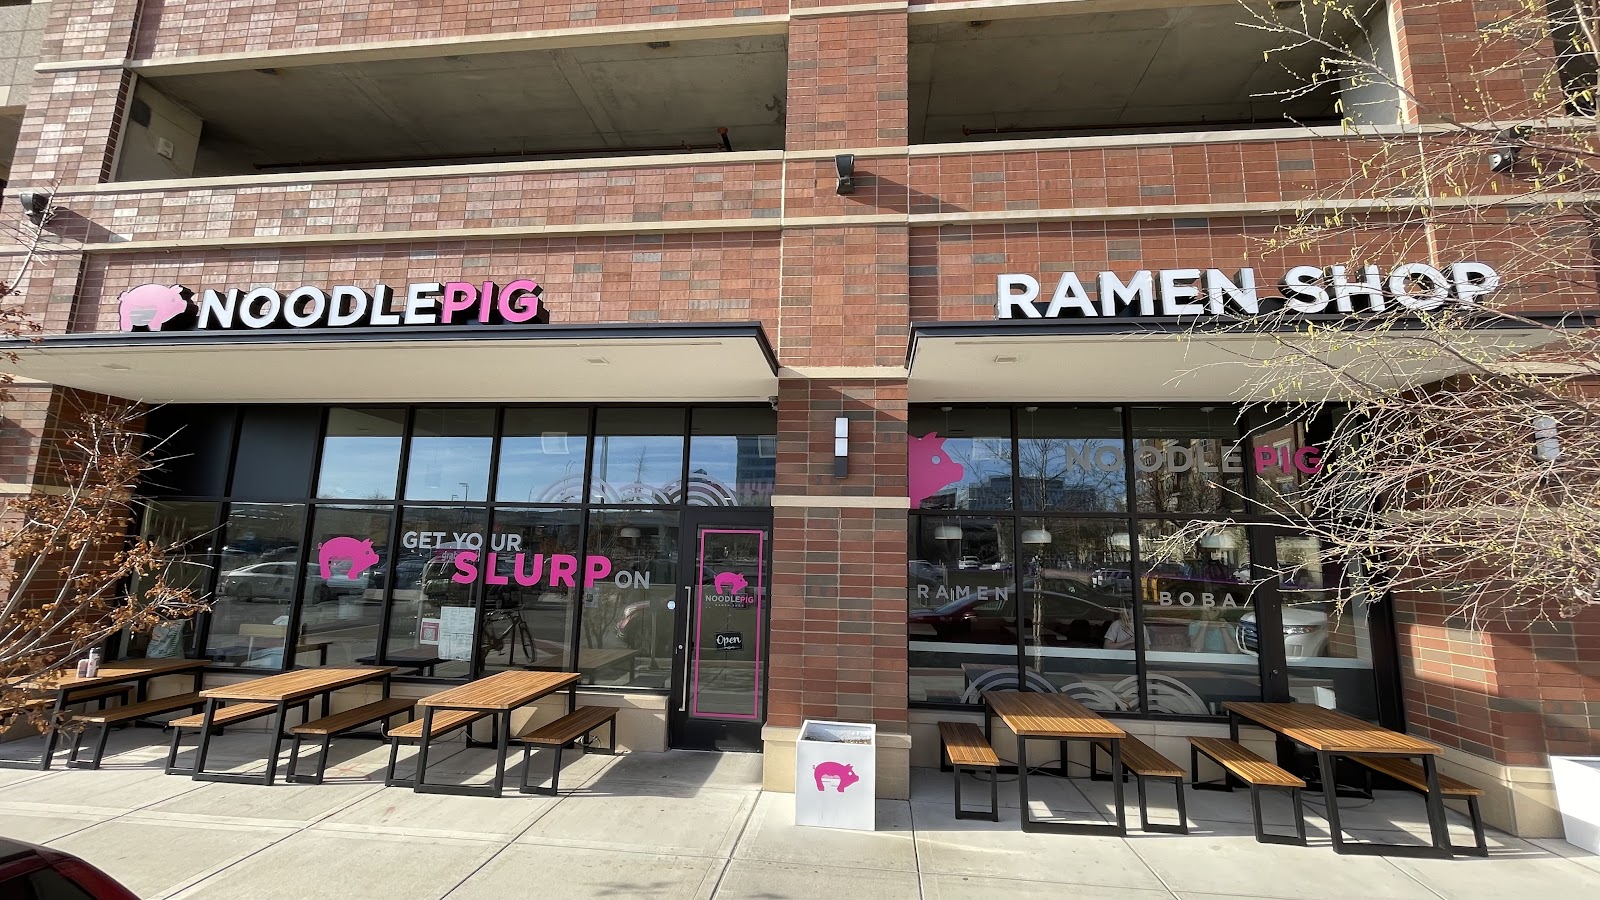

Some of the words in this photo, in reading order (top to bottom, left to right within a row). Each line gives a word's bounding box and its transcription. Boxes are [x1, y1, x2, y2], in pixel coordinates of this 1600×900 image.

[996, 267, 1260, 319] RAMEN
[1282, 261, 1500, 314] SHOP
[402, 531, 447, 550] GET
[452, 531, 523, 552] YOUR
[451, 551, 612, 588] SLURP
[614, 570, 650, 590] ON
[917, 584, 1009, 601] RAMEN
[1159, 591, 1237, 608] BOBA
[716, 634, 742, 647] Open
